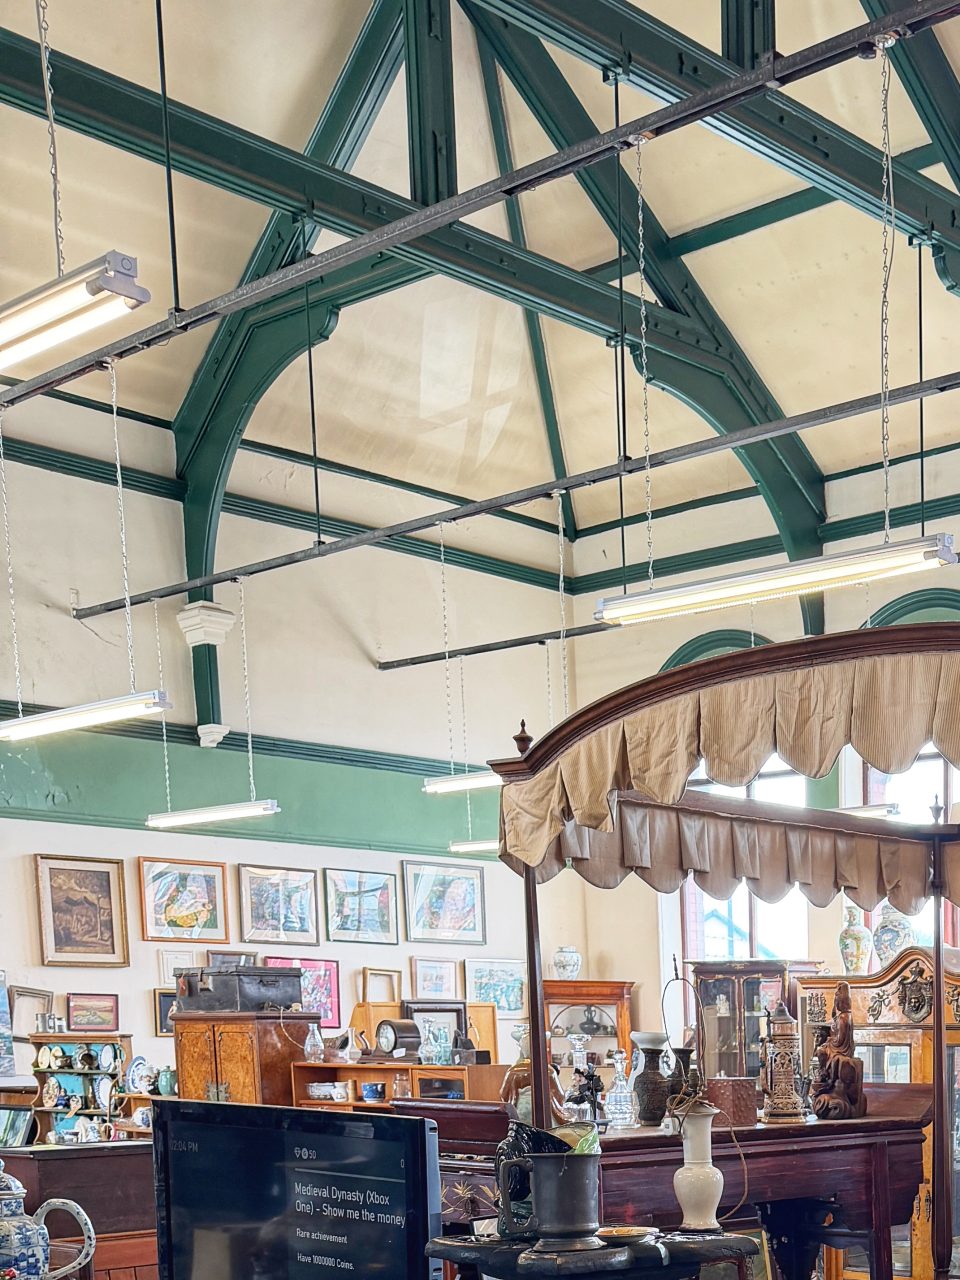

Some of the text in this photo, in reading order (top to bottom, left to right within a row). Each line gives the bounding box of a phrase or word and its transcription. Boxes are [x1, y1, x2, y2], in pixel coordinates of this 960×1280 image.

[309, 1150, 316, 1159] 50
[294, 1182, 390, 1205] Medieval Dynasty (Xbox
[295, 1200, 314, 1215] One)
[322, 1203, 344, 1218] Show
[346, 1209, 359, 1220] me
[362, 1209, 375, 1221] the
[377, 1213, 405, 1228] money
[296, 1228, 347, 1244] Rare achievement
[297, 1253, 311, 1263] Have
[336, 1259, 355, 1270] Coins.
